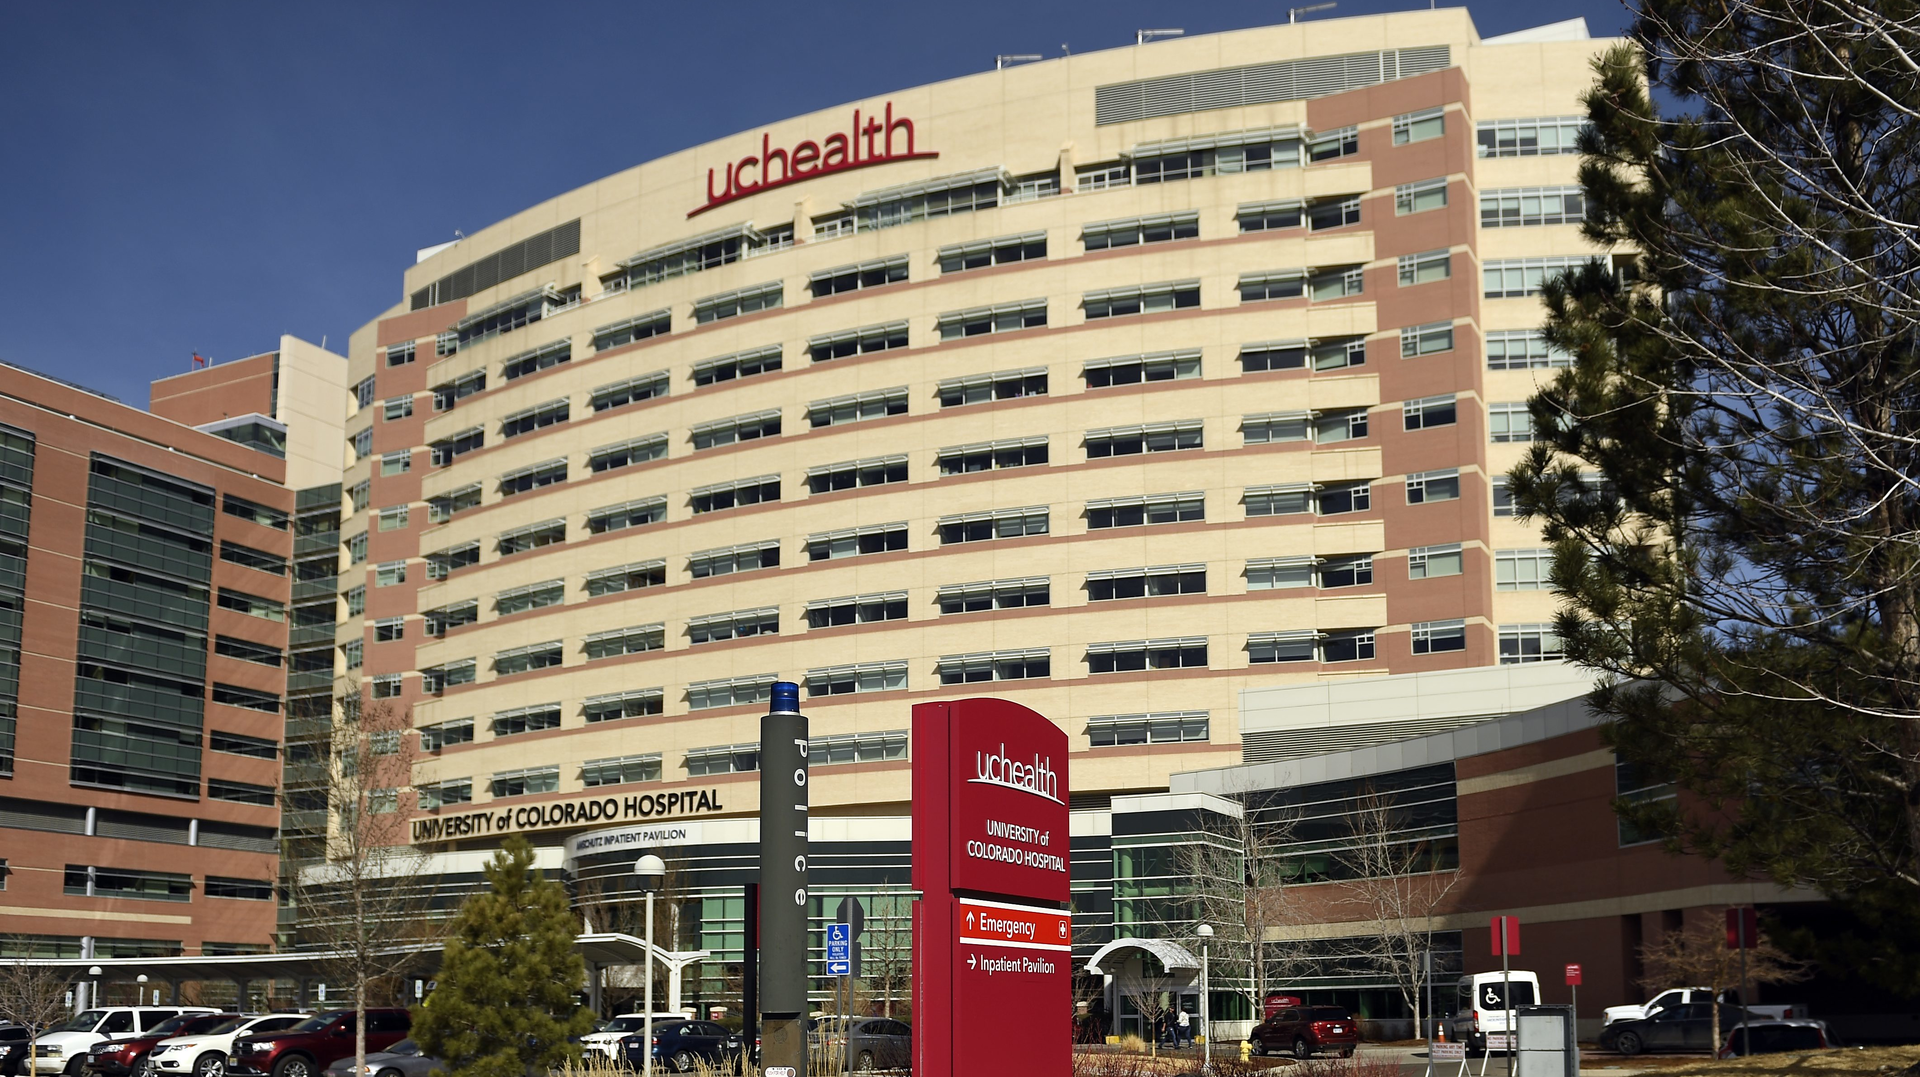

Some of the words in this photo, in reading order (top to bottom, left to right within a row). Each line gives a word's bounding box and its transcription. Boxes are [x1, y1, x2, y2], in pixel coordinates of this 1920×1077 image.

[703, 100, 920, 208] uchealth
[975, 742, 1058, 801] uchealth
[413, 811, 494, 840] UNIVERSITY
[496, 808, 512, 830] of
[515, 798, 619, 828] COLORADO
[623, 789, 723, 818] HOSPITAL
[793, 738, 808, 906] Police
[604, 832, 641, 846] INPATIENT
[643, 829, 686, 841] PAVILION
[987, 819, 1040, 844] UNIVERSITY
[1040, 831, 1050, 846] of
[967, 840, 1023, 865] COLORADO
[1024, 850, 1066, 873] HOSPITAL
[980, 912, 1036, 940] Emergency
[980, 954, 1021, 976] Inpatient
[1022, 956, 1055, 974] Pavilion
